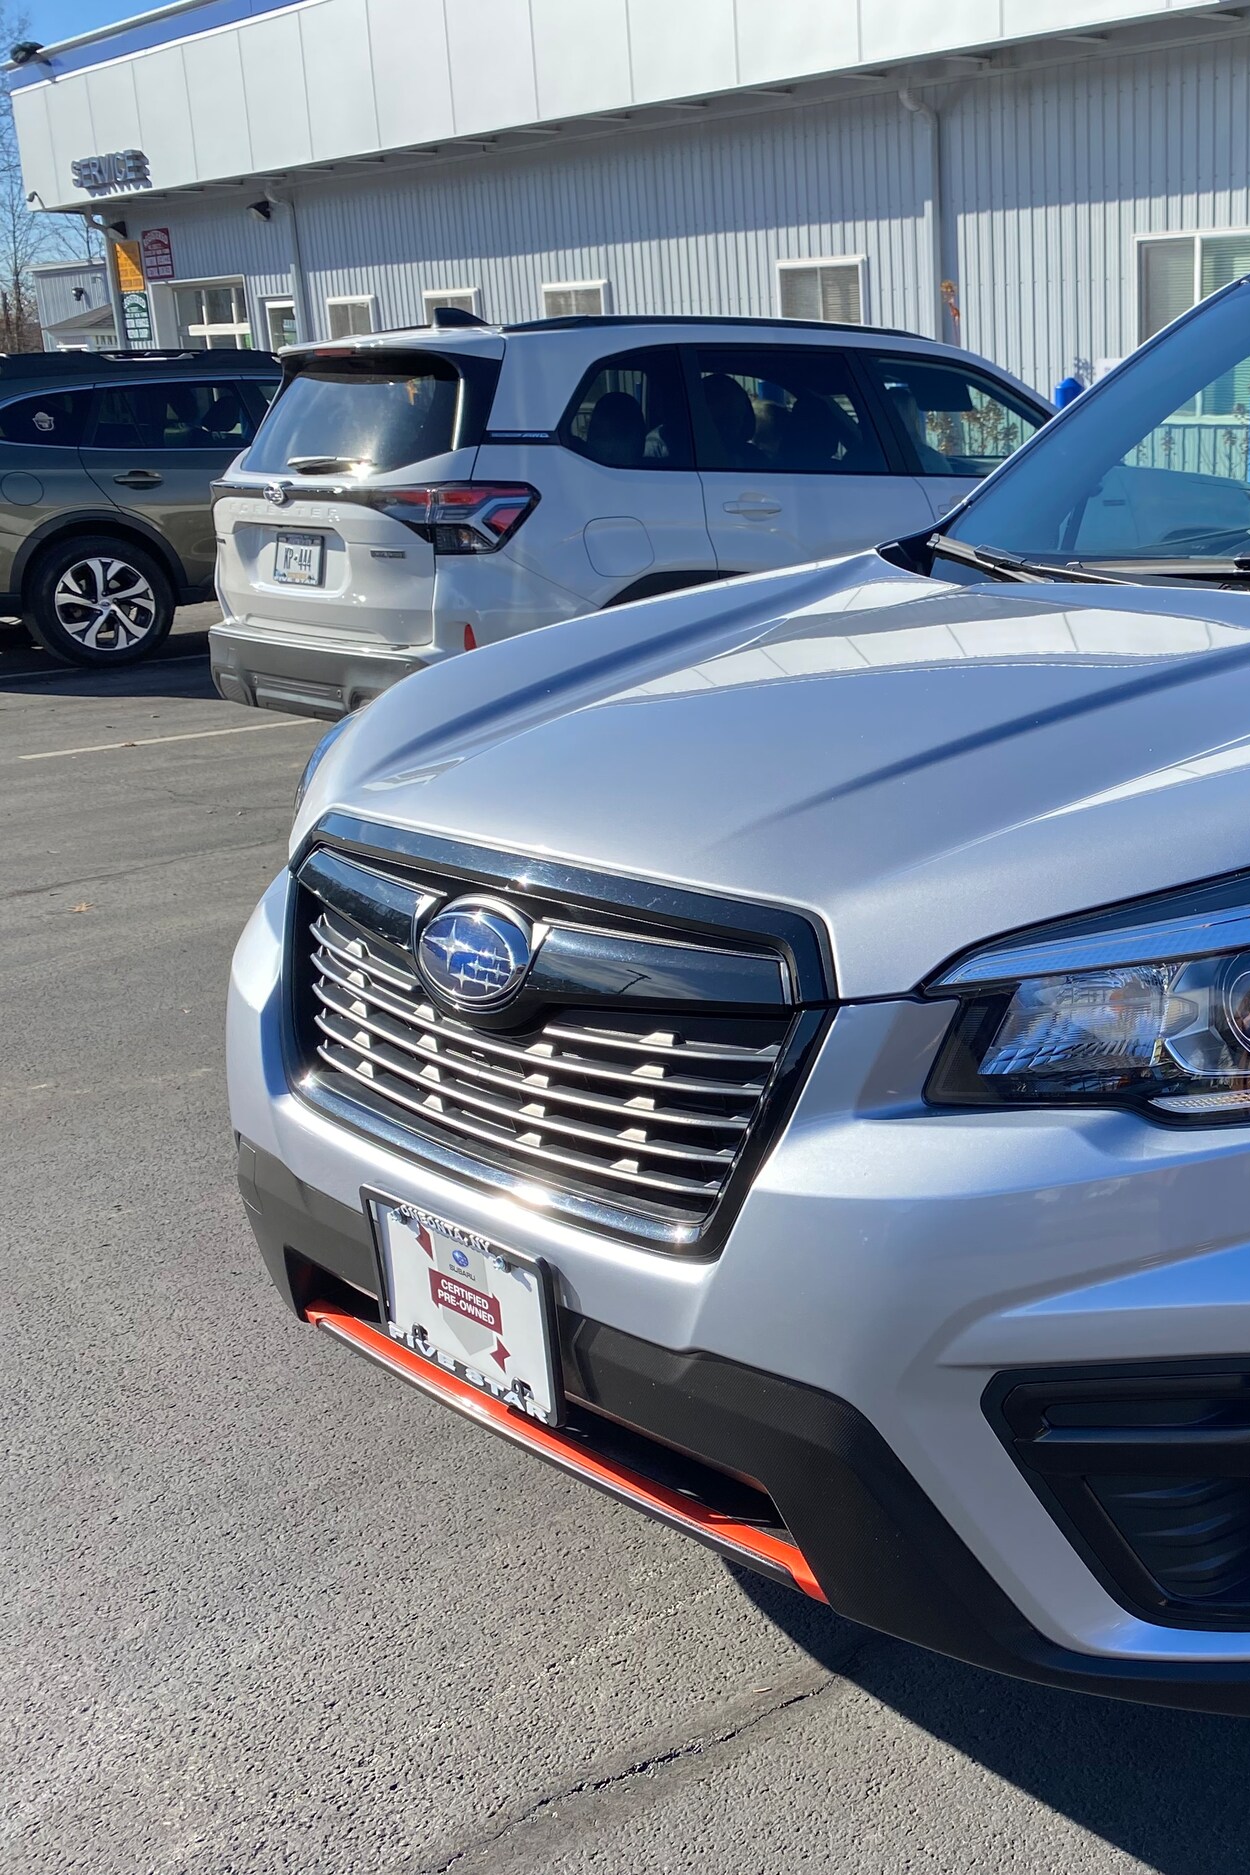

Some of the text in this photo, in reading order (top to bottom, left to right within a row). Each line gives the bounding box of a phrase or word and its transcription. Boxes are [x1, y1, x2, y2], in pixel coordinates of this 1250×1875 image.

[71, 149, 149, 189] SERVICE
[470, 1234, 490, 1253] NY
[449, 1264, 476, 1281] SUBARU
[437, 1289, 495, 1325] PRE-OWNED
[440, 1278, 489, 1310] CERTIFIED
[388, 1320, 548, 1424] FIVE STAR
